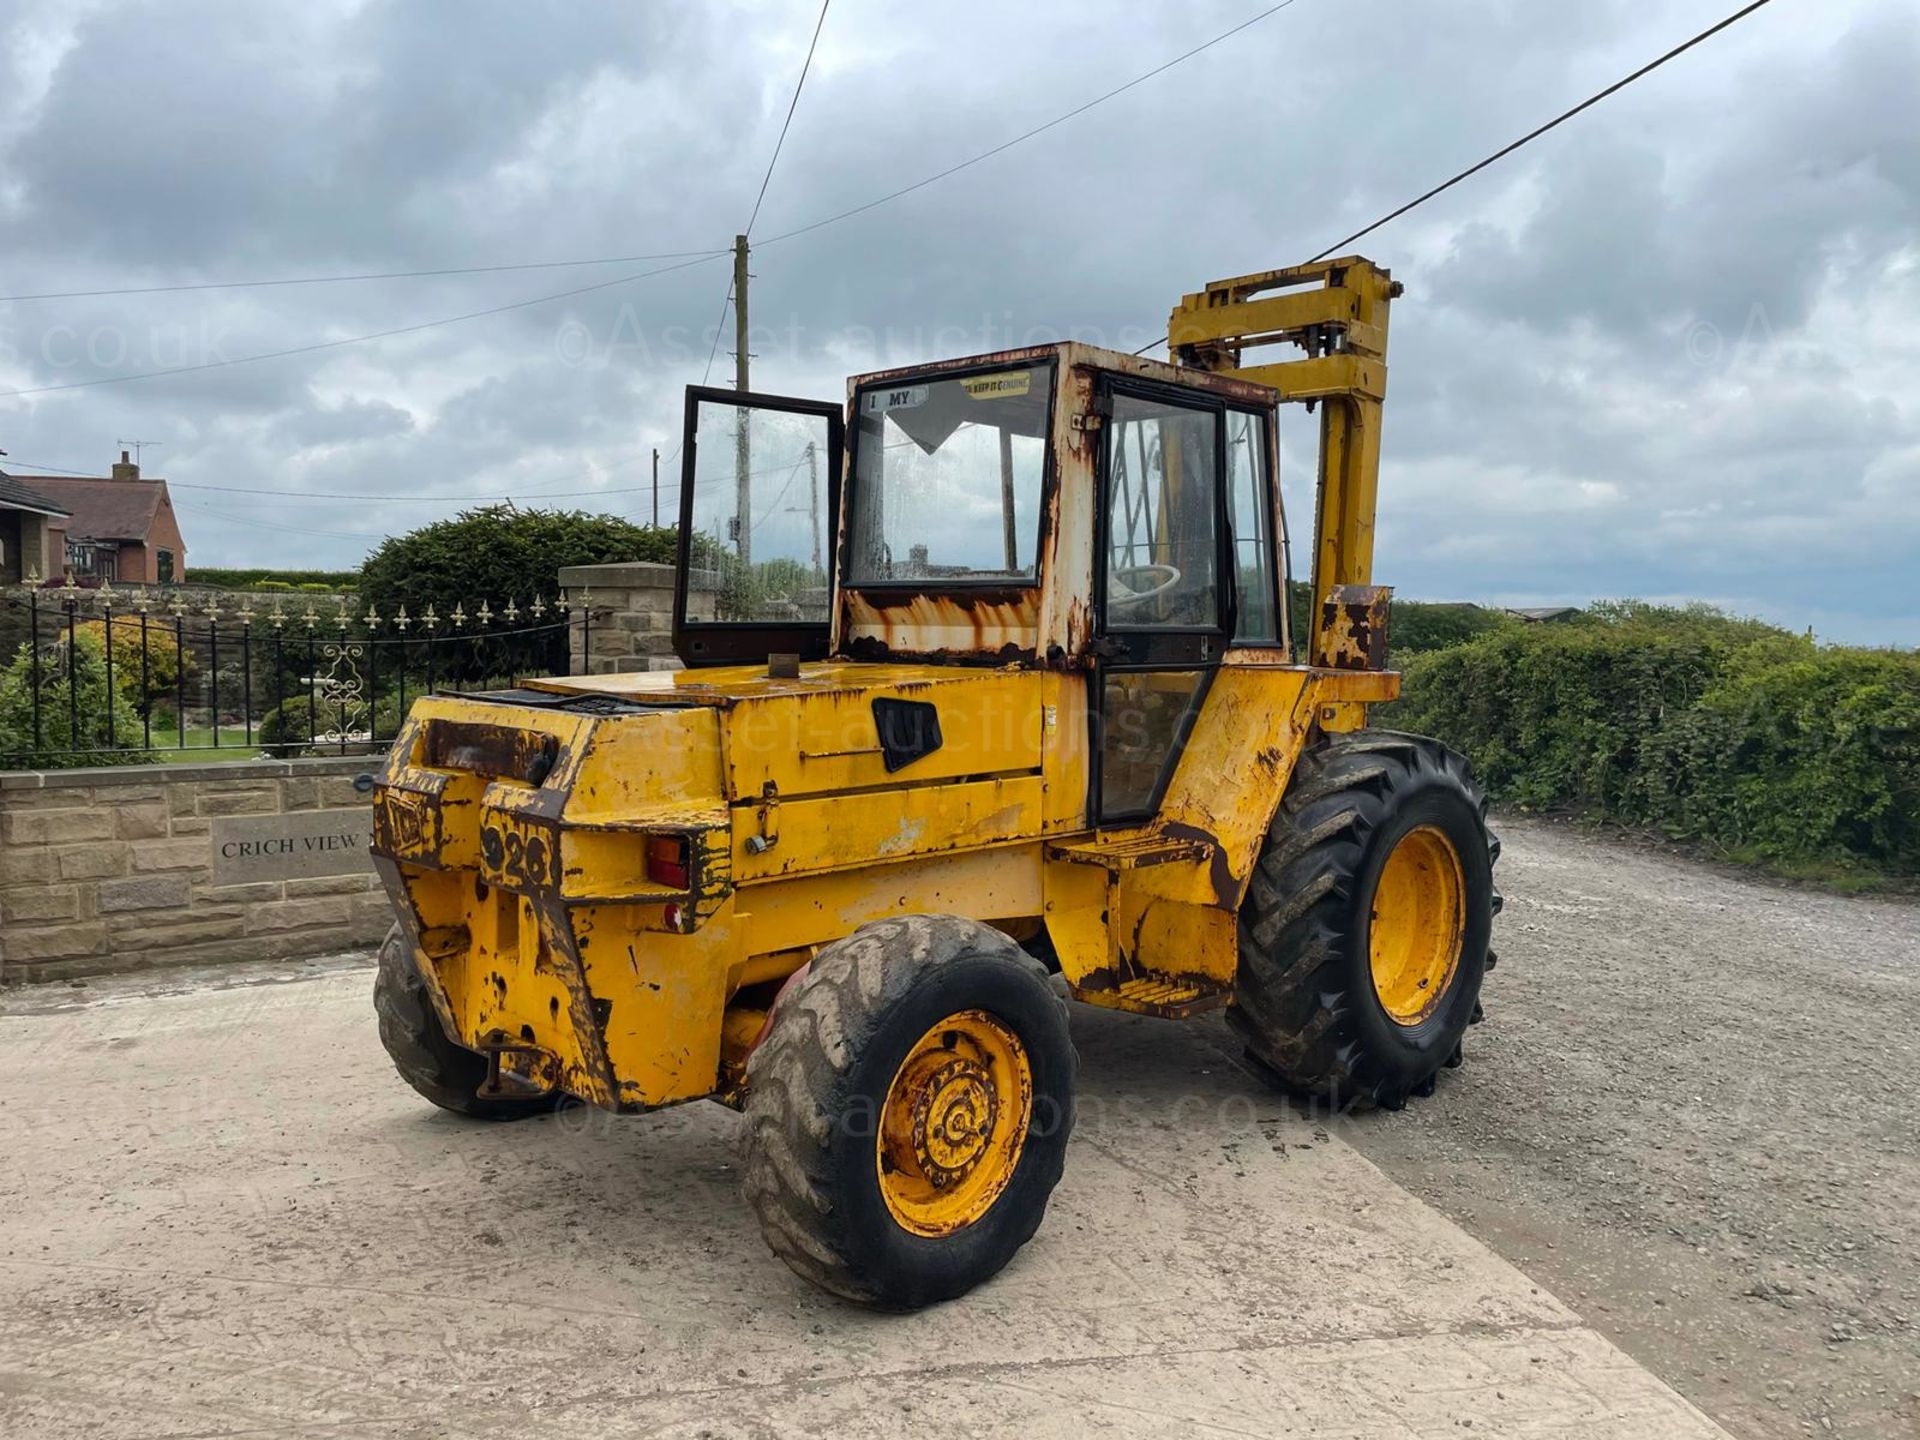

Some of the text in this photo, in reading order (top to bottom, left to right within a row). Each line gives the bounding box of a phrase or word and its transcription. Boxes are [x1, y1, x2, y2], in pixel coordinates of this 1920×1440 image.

[889, 391, 910, 406] MY
[222, 838, 294, 858] CRICH
[303, 833, 360, 851] VIEW
